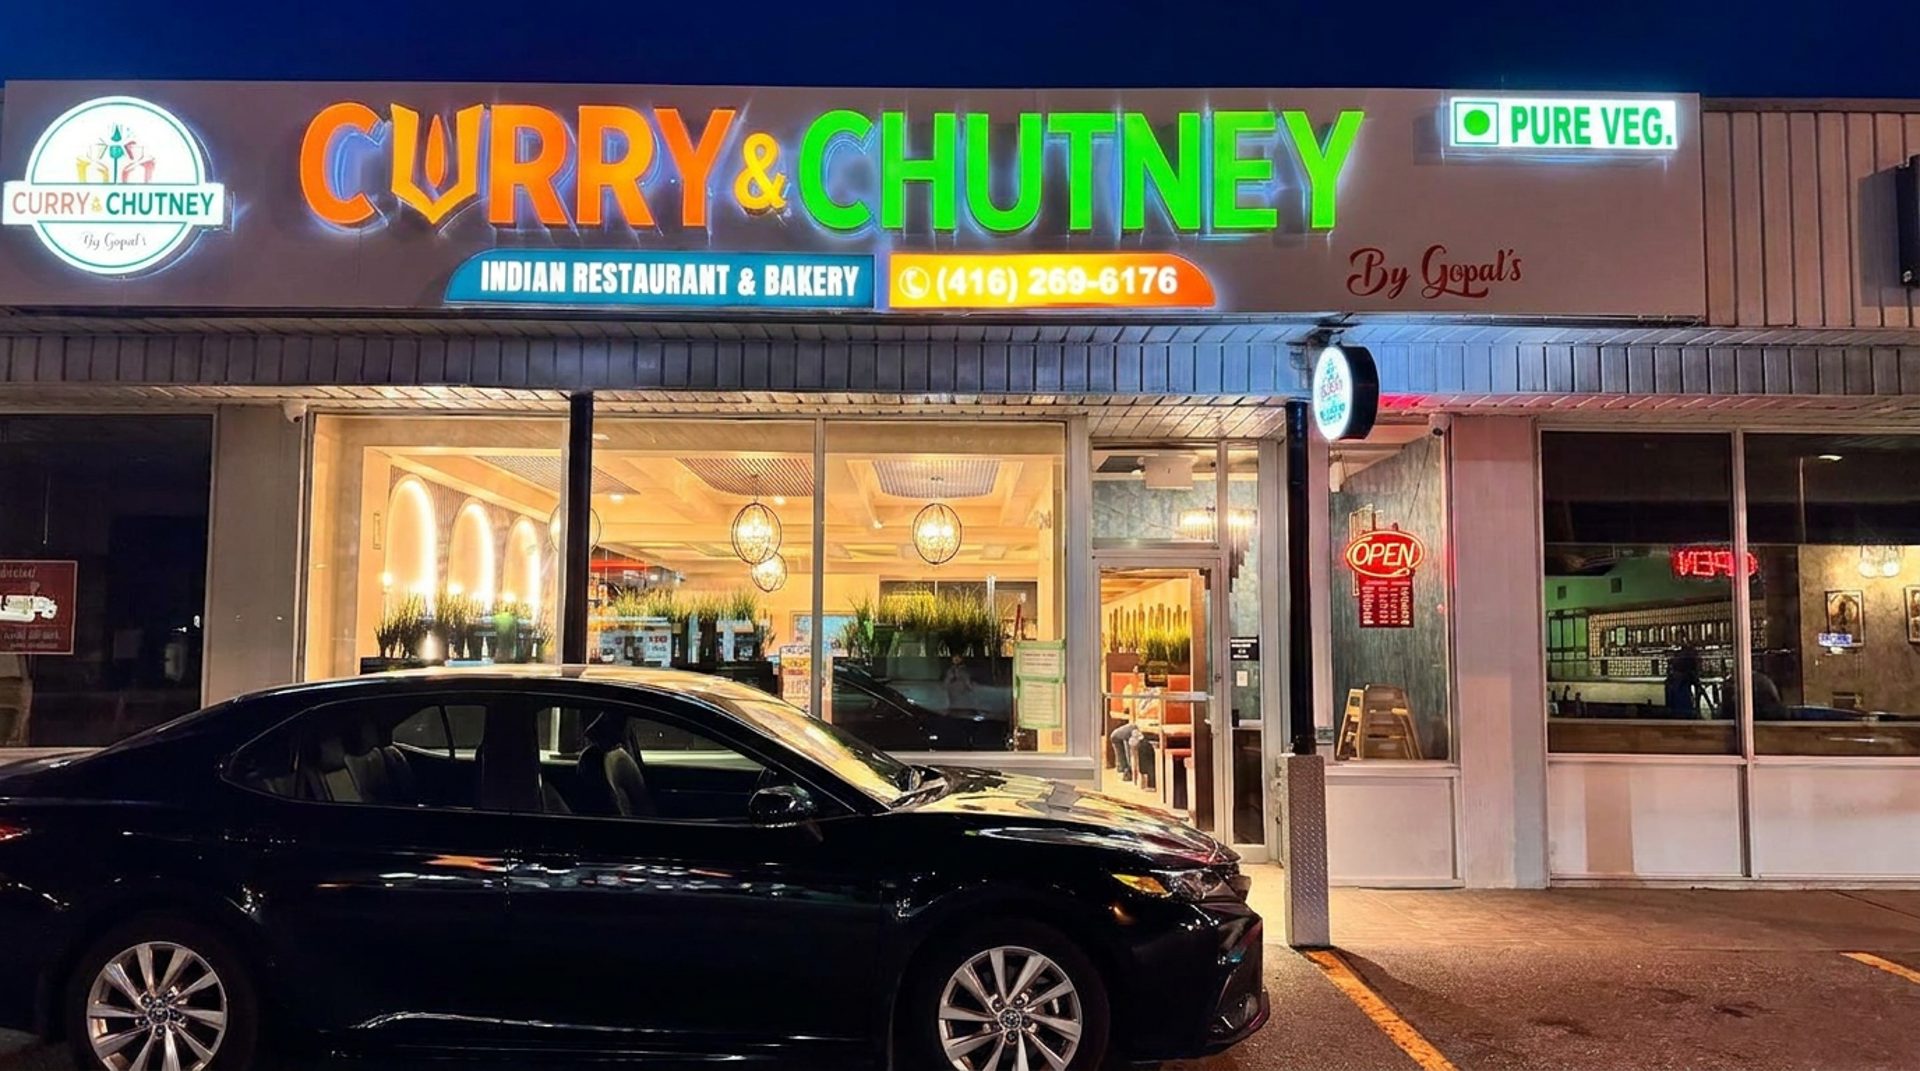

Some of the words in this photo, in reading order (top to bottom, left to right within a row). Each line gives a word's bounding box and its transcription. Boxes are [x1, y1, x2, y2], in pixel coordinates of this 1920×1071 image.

[1510, 106, 1592, 144] PURE
[1600, 107, 1673, 145] VEG.
[300, 102, 737, 228] CURRY
[733, 132, 787, 210] &
[799, 109, 1366, 231] CHUTNEY
[12, 191, 90, 215] CURRY
[106, 192, 214, 216] CHUTNEY
[480, 260, 566, 293] INDIAN
[573, 262, 730, 295] RESTAURANT
[738, 267, 756, 296] &
[764, 265, 860, 297] BAKERY
[936, 265, 1019, 304] (416)
[1027, 265, 1178, 296] 269-6176
[1346, 247, 1411, 300] By
[1421, 244, 1522, 299] Gopal's
[1352, 542, 1416, 567] OPEN
